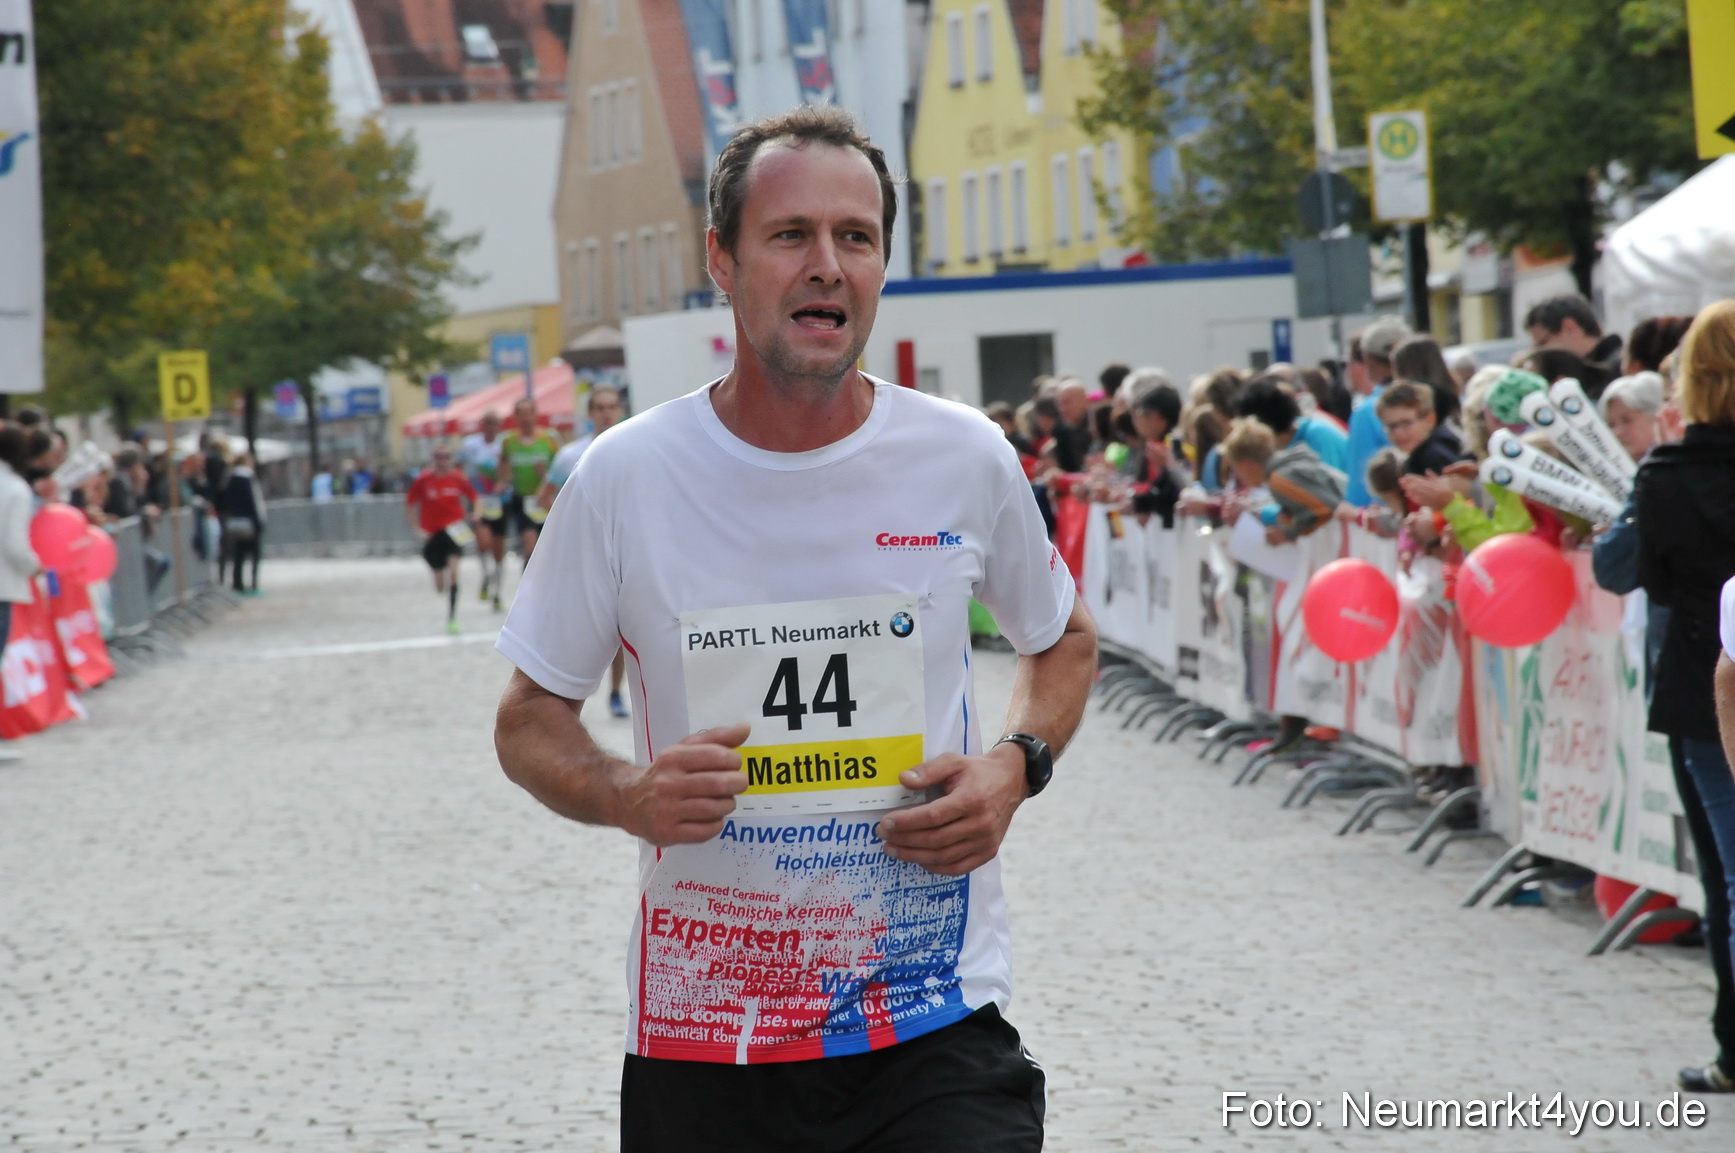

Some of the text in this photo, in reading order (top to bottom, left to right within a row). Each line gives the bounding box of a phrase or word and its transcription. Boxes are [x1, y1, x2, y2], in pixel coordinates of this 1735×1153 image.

[173, 372, 197, 406] D
[875, 531, 963, 547] CeramTec
[688, 619, 881, 651] PARTL Neumarkt
[762, 652, 857, 731] 44
[747, 752, 878, 787] Matthias
[675, 880, 781, 903] Advanced Ceramics
[706, 898, 856, 921] Technische Keramik
[650, 908, 801, 952] Experten
[706, 962, 818, 985] Pioneers
[792, 1017, 821, 1028] well
[825, 1011, 850, 1027] over
[885, 1002, 930, 1026] variety
